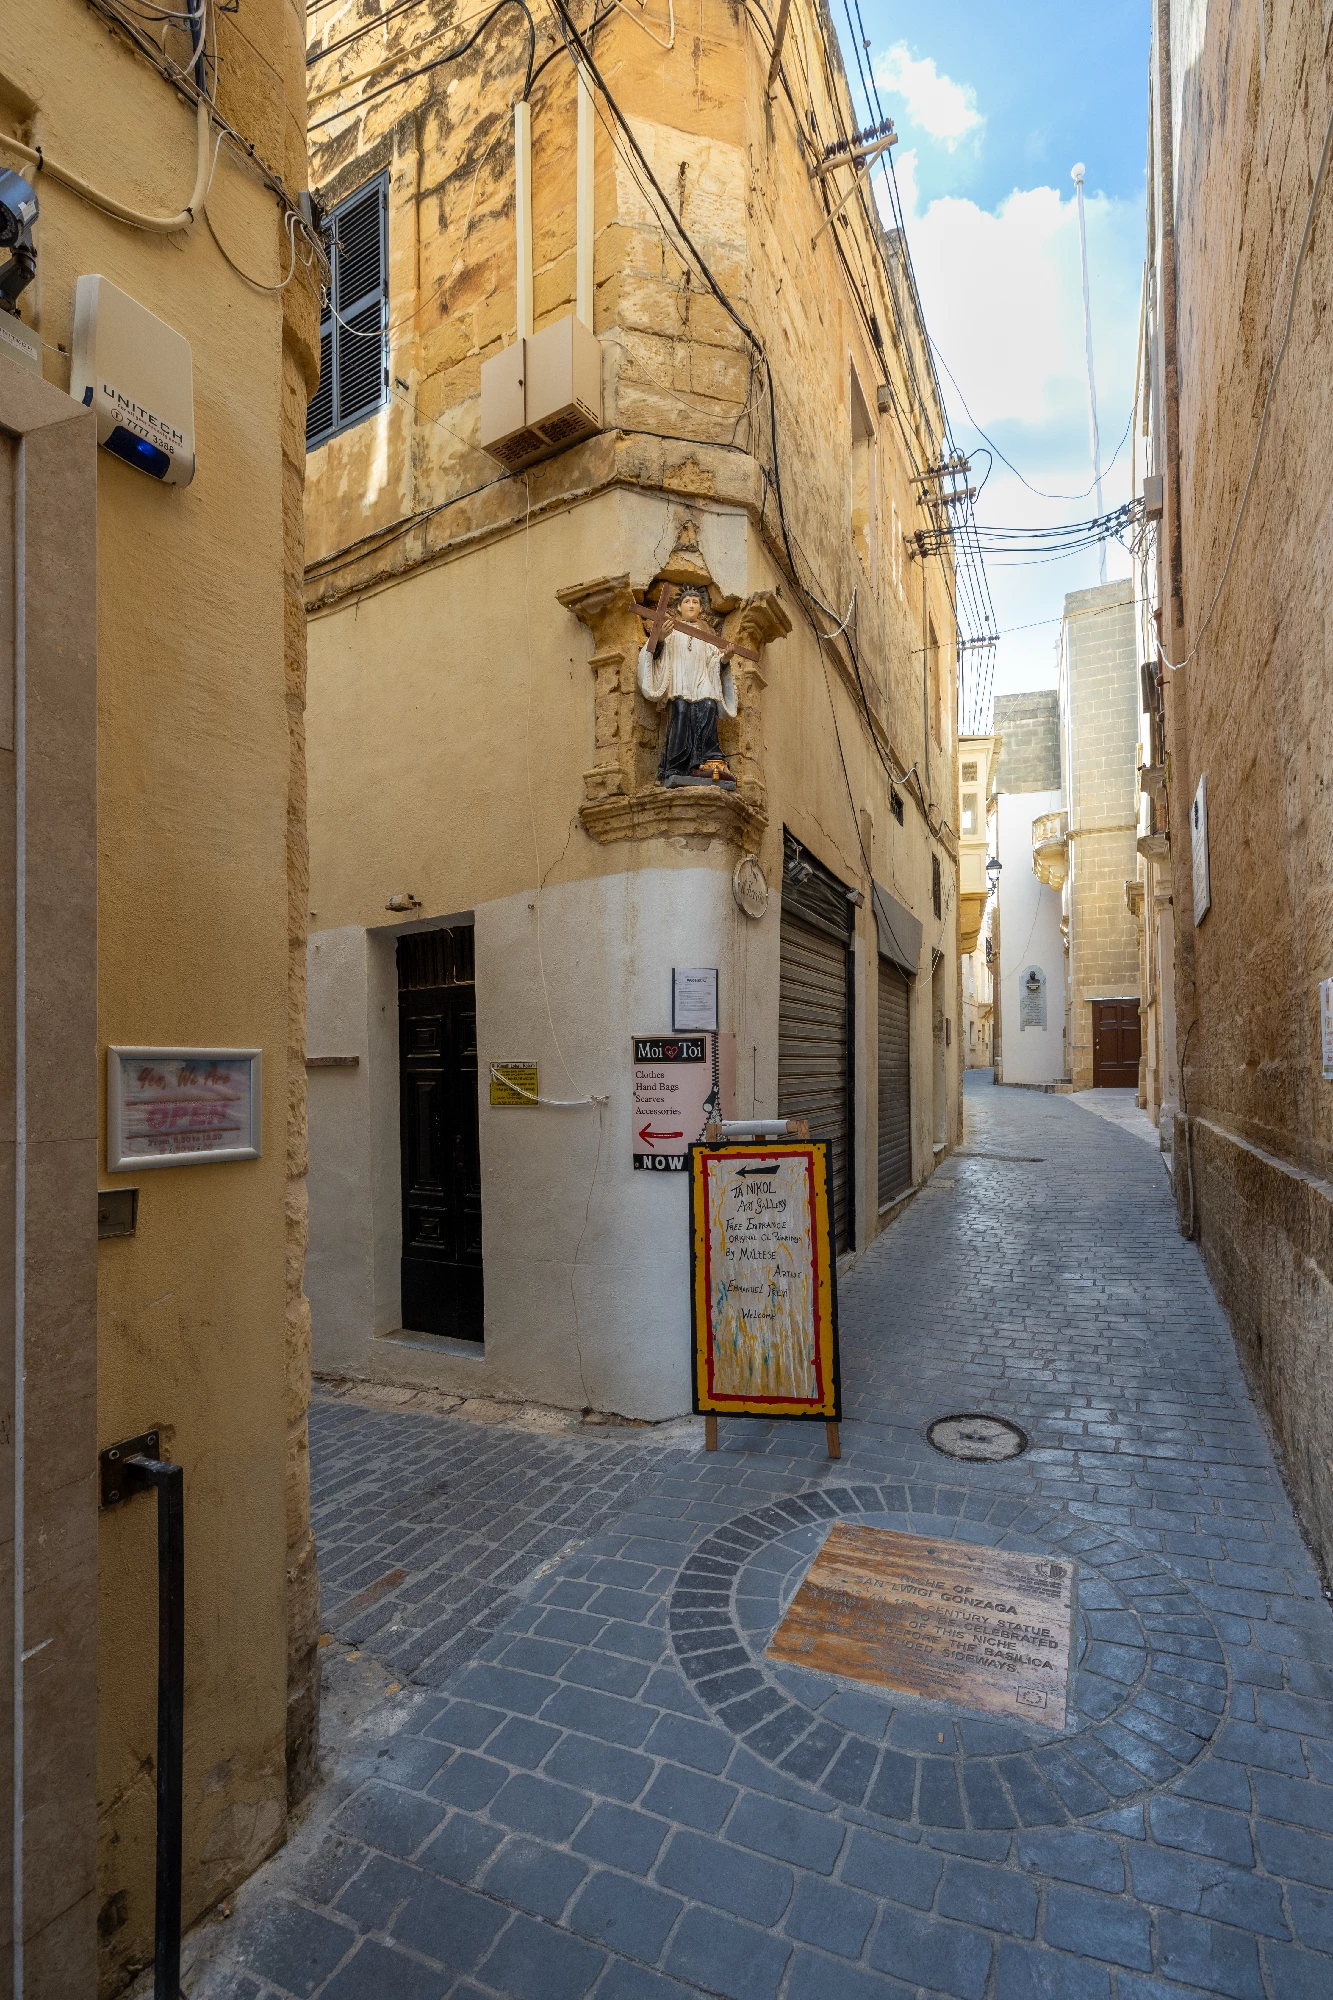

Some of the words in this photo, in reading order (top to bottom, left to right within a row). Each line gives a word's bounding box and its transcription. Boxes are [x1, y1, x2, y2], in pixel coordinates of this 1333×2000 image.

[103, 384, 183, 443] UNITECH
[126, 417, 150, 438] 7777
[152, 434, 175, 455] 3388
[637, 1042, 663, 1058] Moi
[678, 1041, 702, 1058] Toi
[175, 1066, 199, 1088] We
[203, 1065, 231, 1087] Are
[635, 1070, 665, 1079] Clothes
[635, 1082, 657, 1091] Hand
[658, 1082, 680, 1093] Bags
[635, 1094, 665, 1103] Scarves
[635, 1106, 682, 1115] Accessories
[146, 1100, 230, 1129] OPEN
[642, 1155, 684, 1170] NOW
[856, 1575, 885, 1588] SAN
[890, 1581, 932, 1597] LWIGI
[940, 1592, 1018, 1616] GONZAGA
[900, 1574, 945, 1590] NICHE
[952, 1584, 975, 1595] OF
[908, 1620, 928, 1630] OF
[935, 1625, 965, 1640] THIS
[972, 1634, 1017, 1651] NICHE
[914, 1611, 930, 1622] TO
[938, 1617, 956, 1627] BE
[964, 1622, 1059, 1649] CELEBRATED
[926, 1605, 990, 1624] CENTURY
[997, 1619, 1055, 1639] STATUE.
[860, 1630, 934, 1653] EXTENDED
[941, 1648, 1020, 1675] SIDEWAYS.
[884, 1625, 942, 1645] BEFORE
[949, 1639, 978, 1652] THE
[983, 1647, 1054, 1671] BASILICA
